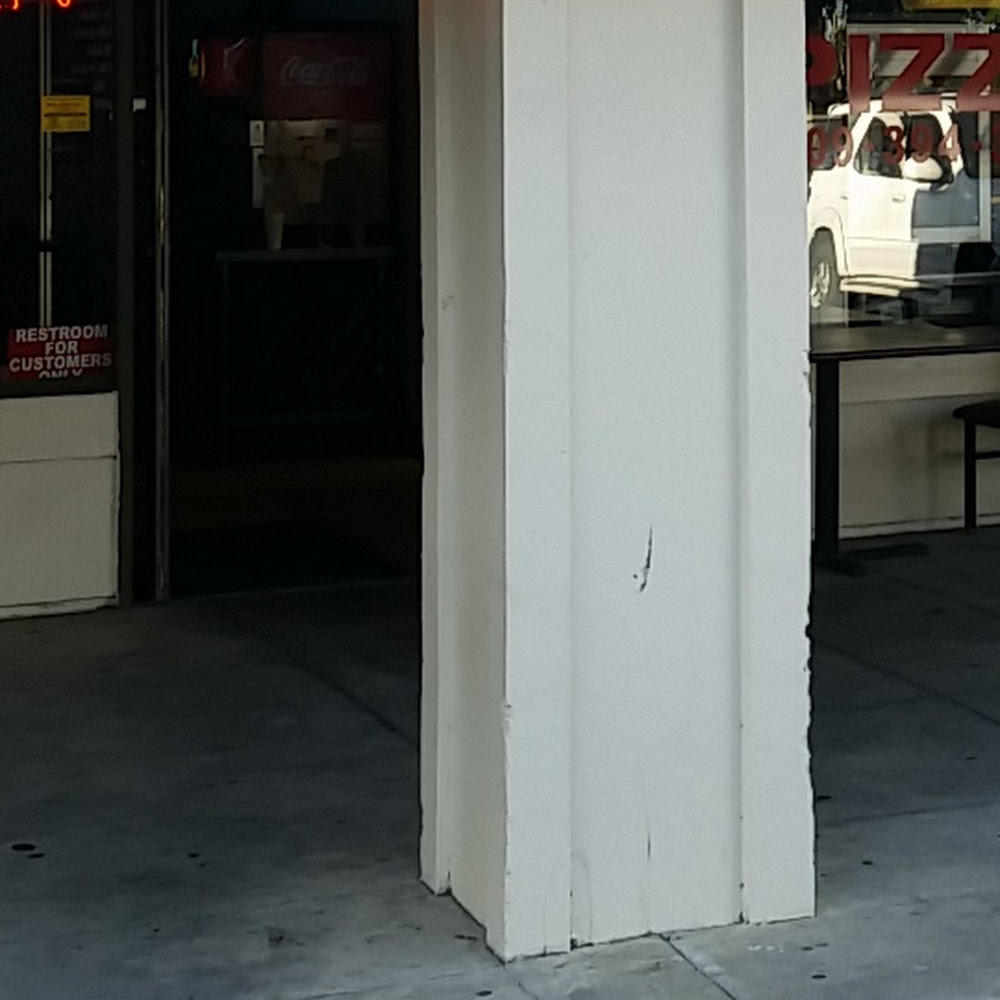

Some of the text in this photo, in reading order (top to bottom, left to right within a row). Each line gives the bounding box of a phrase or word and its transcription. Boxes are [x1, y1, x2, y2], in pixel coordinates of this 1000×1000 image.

[15, 324, 108, 343] RESTROOM
[44, 340, 78, 355] FOR
[8, 353, 112, 373] CUSTOMERS
